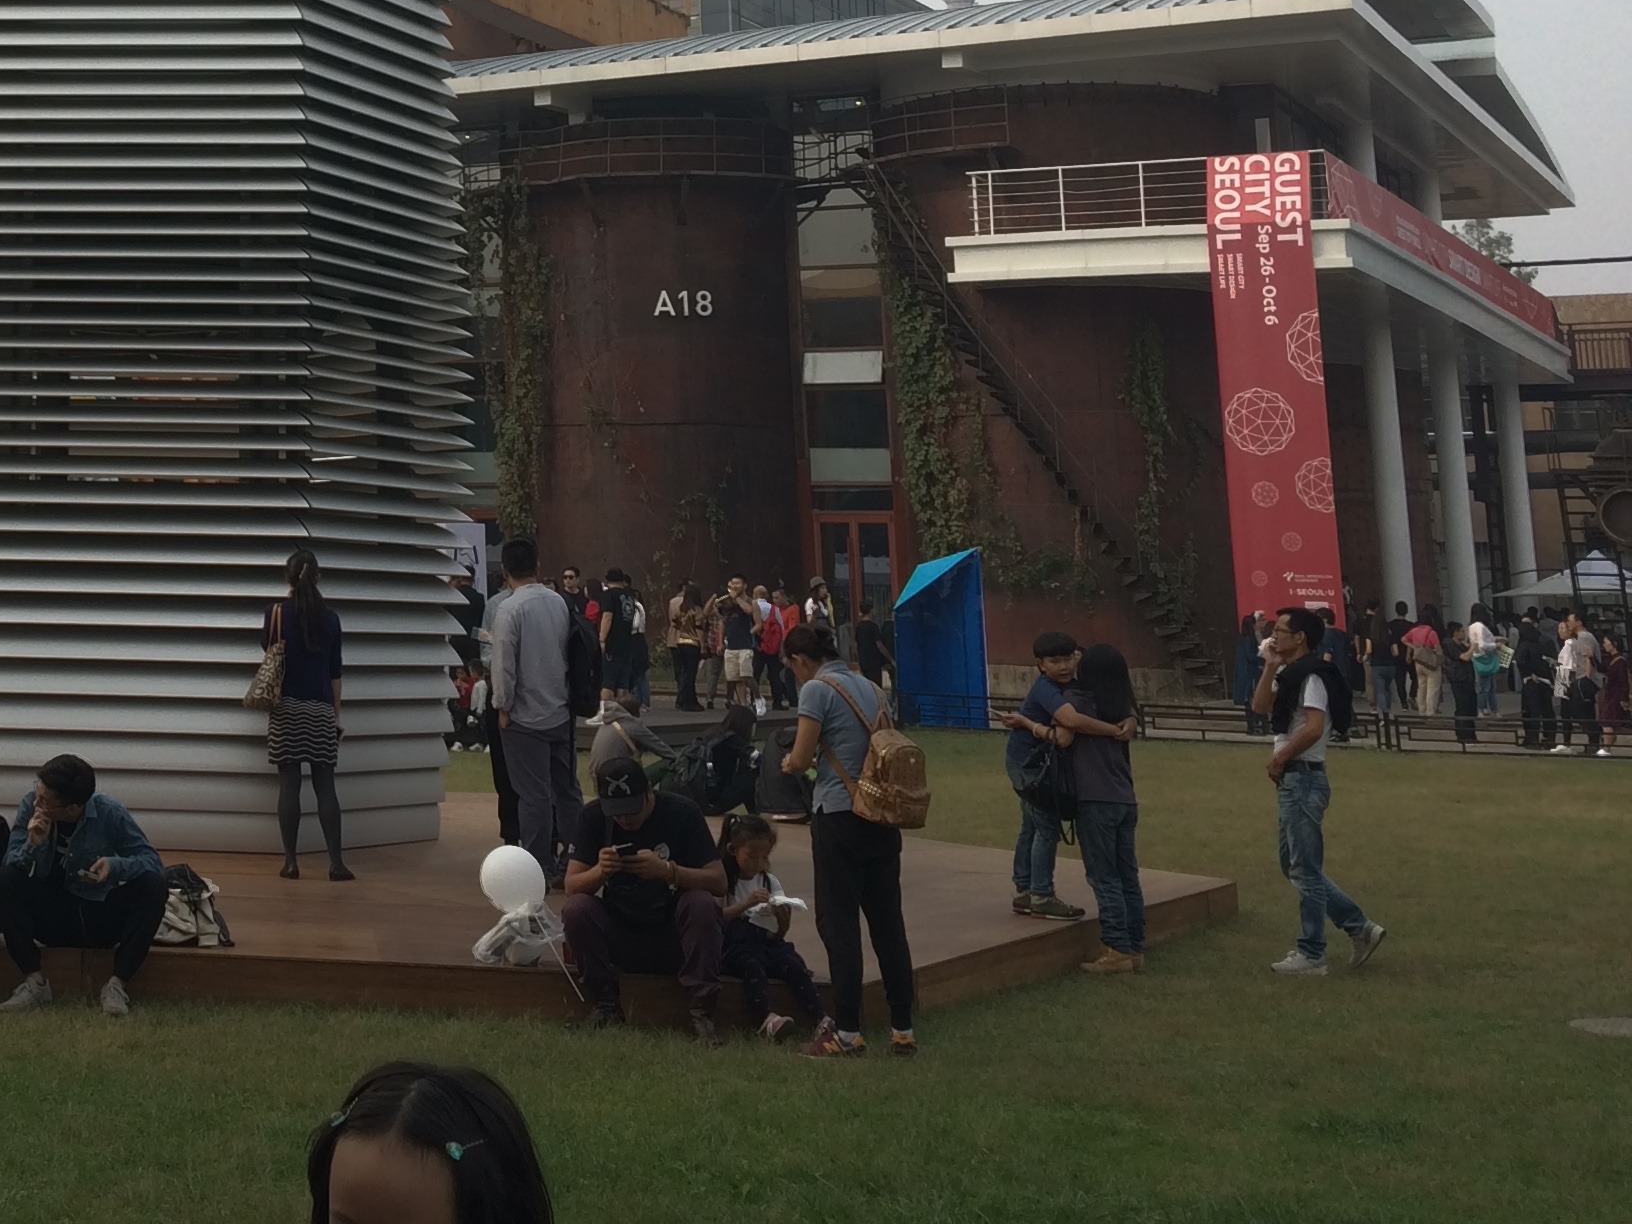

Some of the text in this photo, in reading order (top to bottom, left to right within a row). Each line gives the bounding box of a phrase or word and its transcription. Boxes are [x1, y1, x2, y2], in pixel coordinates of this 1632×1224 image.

[1214, 157, 1242, 250] SEOUL
[1244, 154, 1272, 217] CITY
[1274, 152, 1304, 247] GUEST
[653, 290, 713, 316] A18
[1255, 225, 1272, 254] Sep
[1264, 315, 1279, 326] 6
